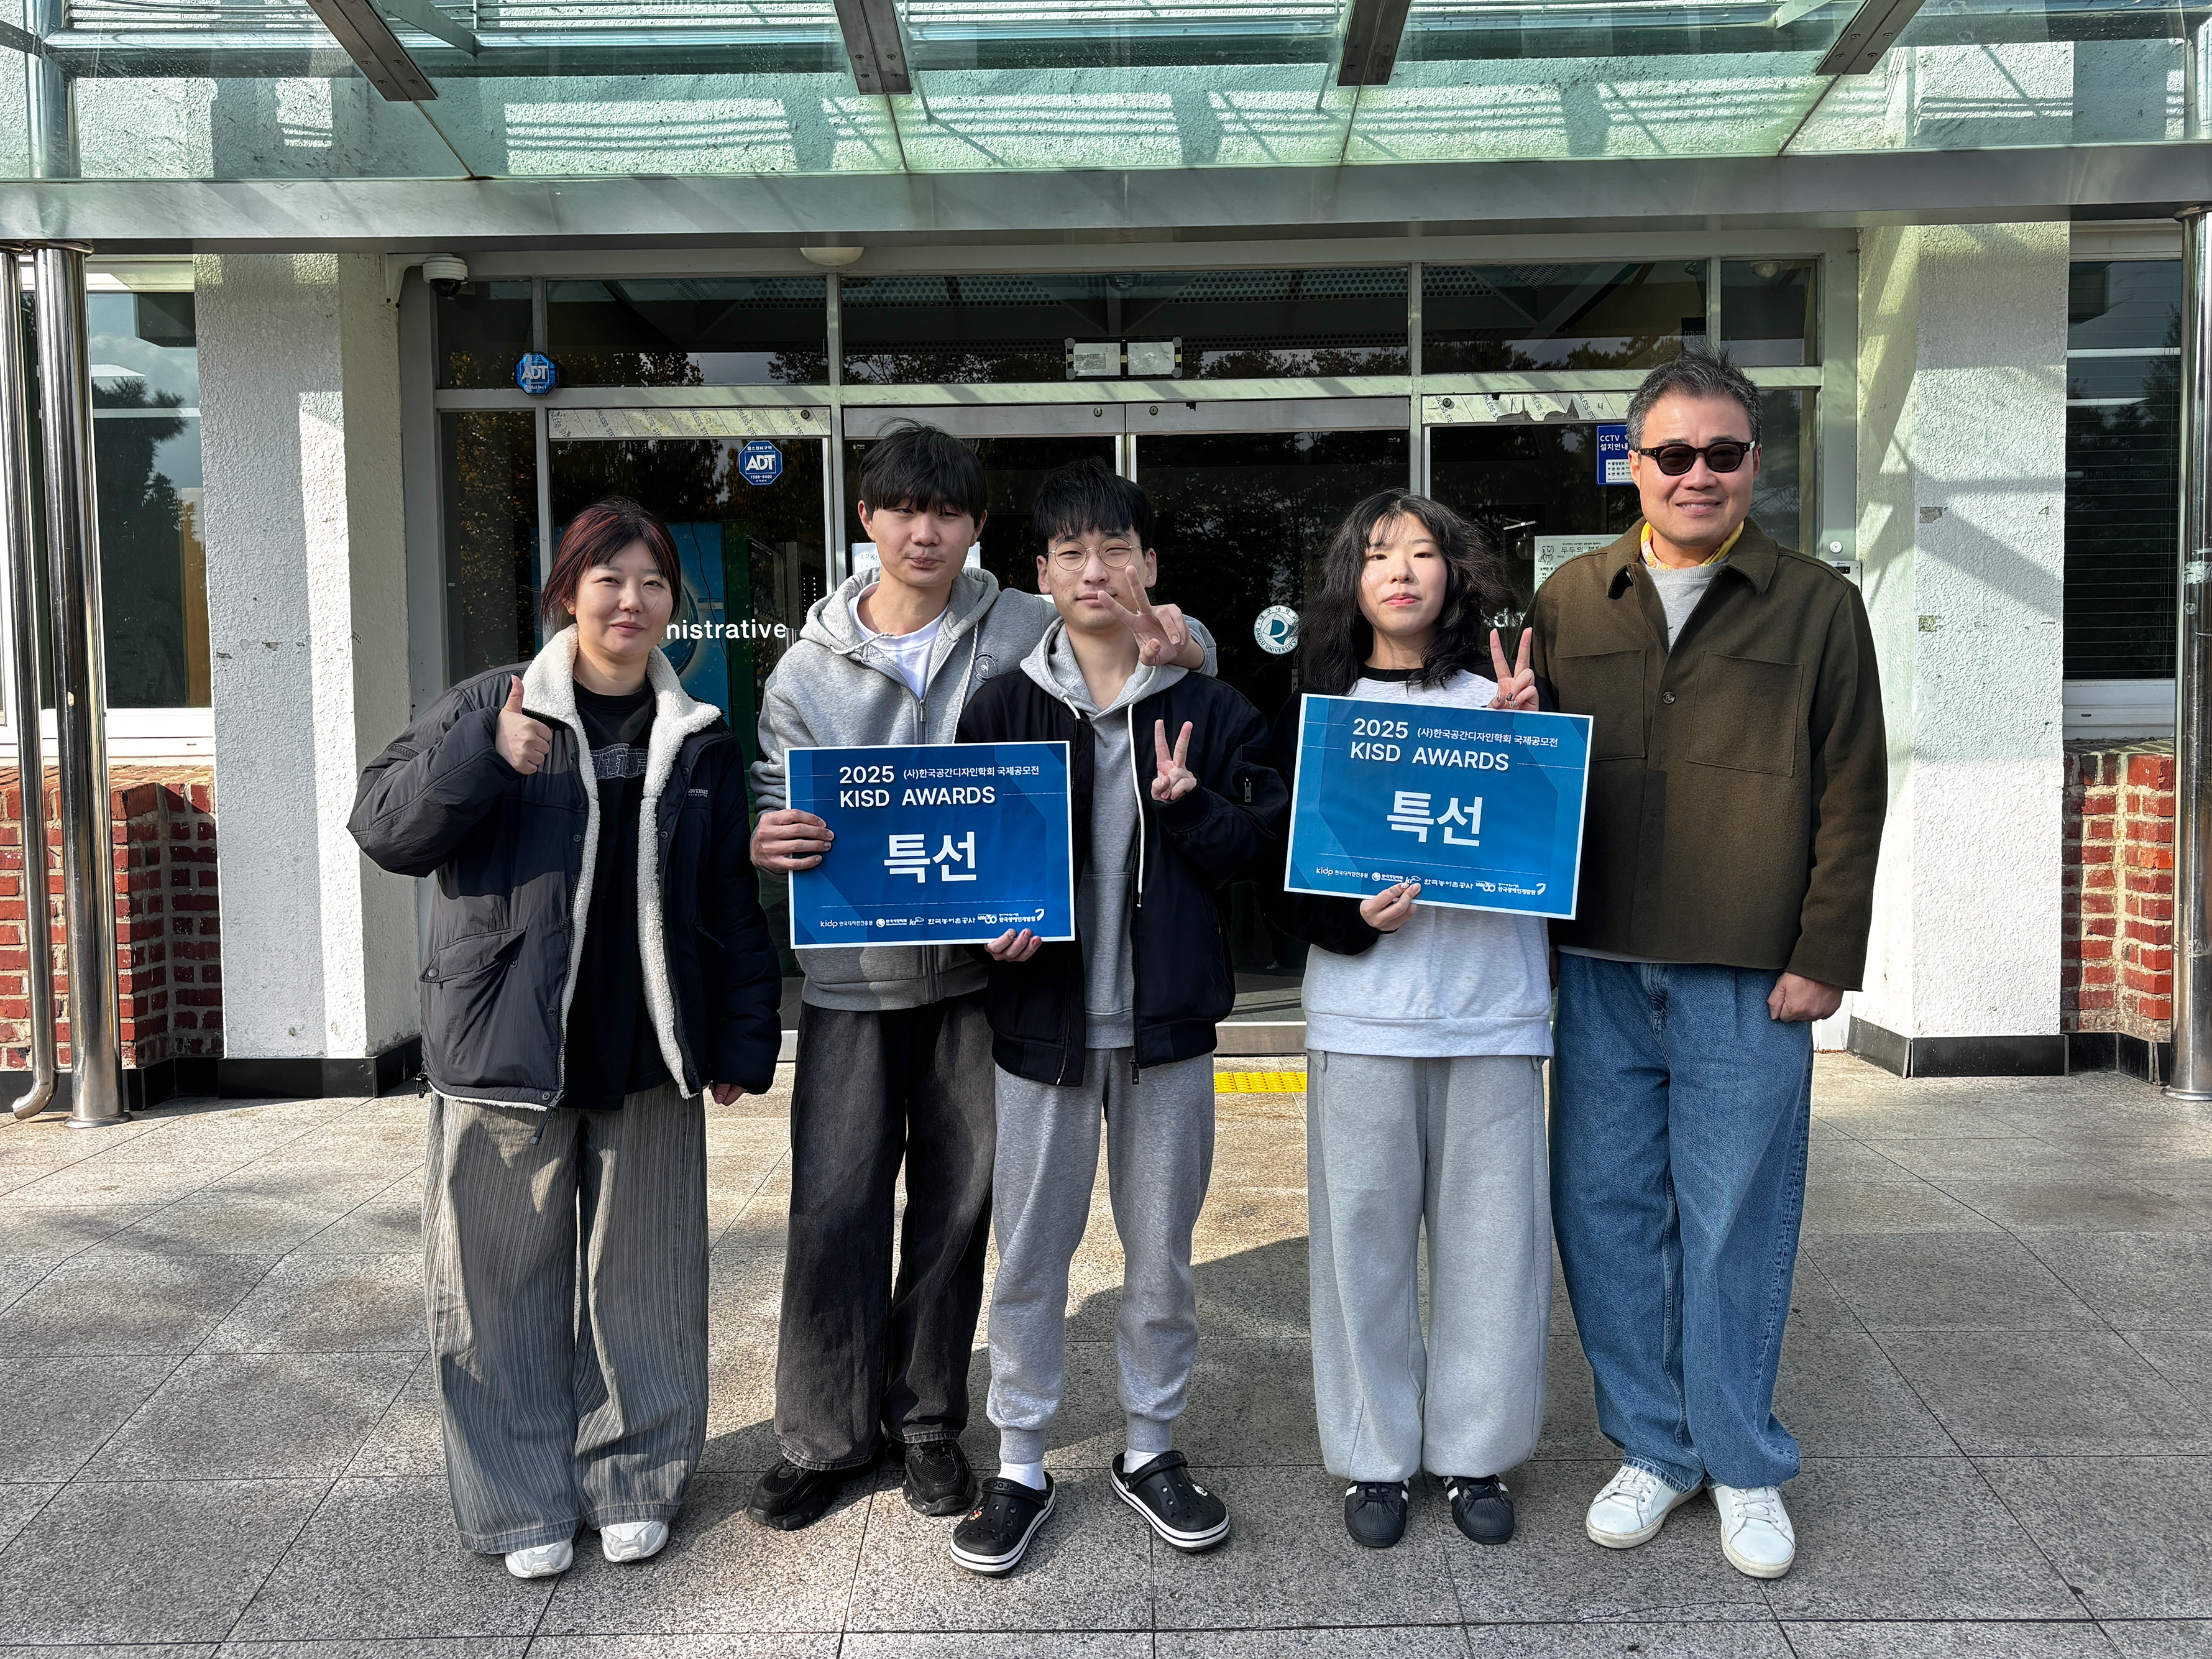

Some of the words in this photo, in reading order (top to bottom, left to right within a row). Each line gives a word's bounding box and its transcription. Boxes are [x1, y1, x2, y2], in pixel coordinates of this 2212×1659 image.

[521, 365, 548, 380] ADT
[1600, 443, 1628, 451] 설치안내
[746, 454, 775, 471] ADT
[666, 619, 787, 639] nistrative
[1352, 718, 1408, 739] 2025
[1417, 727, 1512, 745] (사)한국공간디자인학회
[1514, 735, 1558, 748] 국제공모전
[1350, 742, 1401, 762] KISD
[1412, 746, 1509, 771] AWARDS
[840, 766, 895, 784] 2025
[903, 766, 995, 780] (사)한국공간디자인학회
[997, 765, 1040, 777] 국제공모전
[840, 789, 890, 808] KISD
[902, 786, 996, 806] AWARDS
[1387, 791, 1483, 847] 특선
[884, 832, 977, 883] 특선
[1424, 879, 1474, 889] 한국농어촌공사
